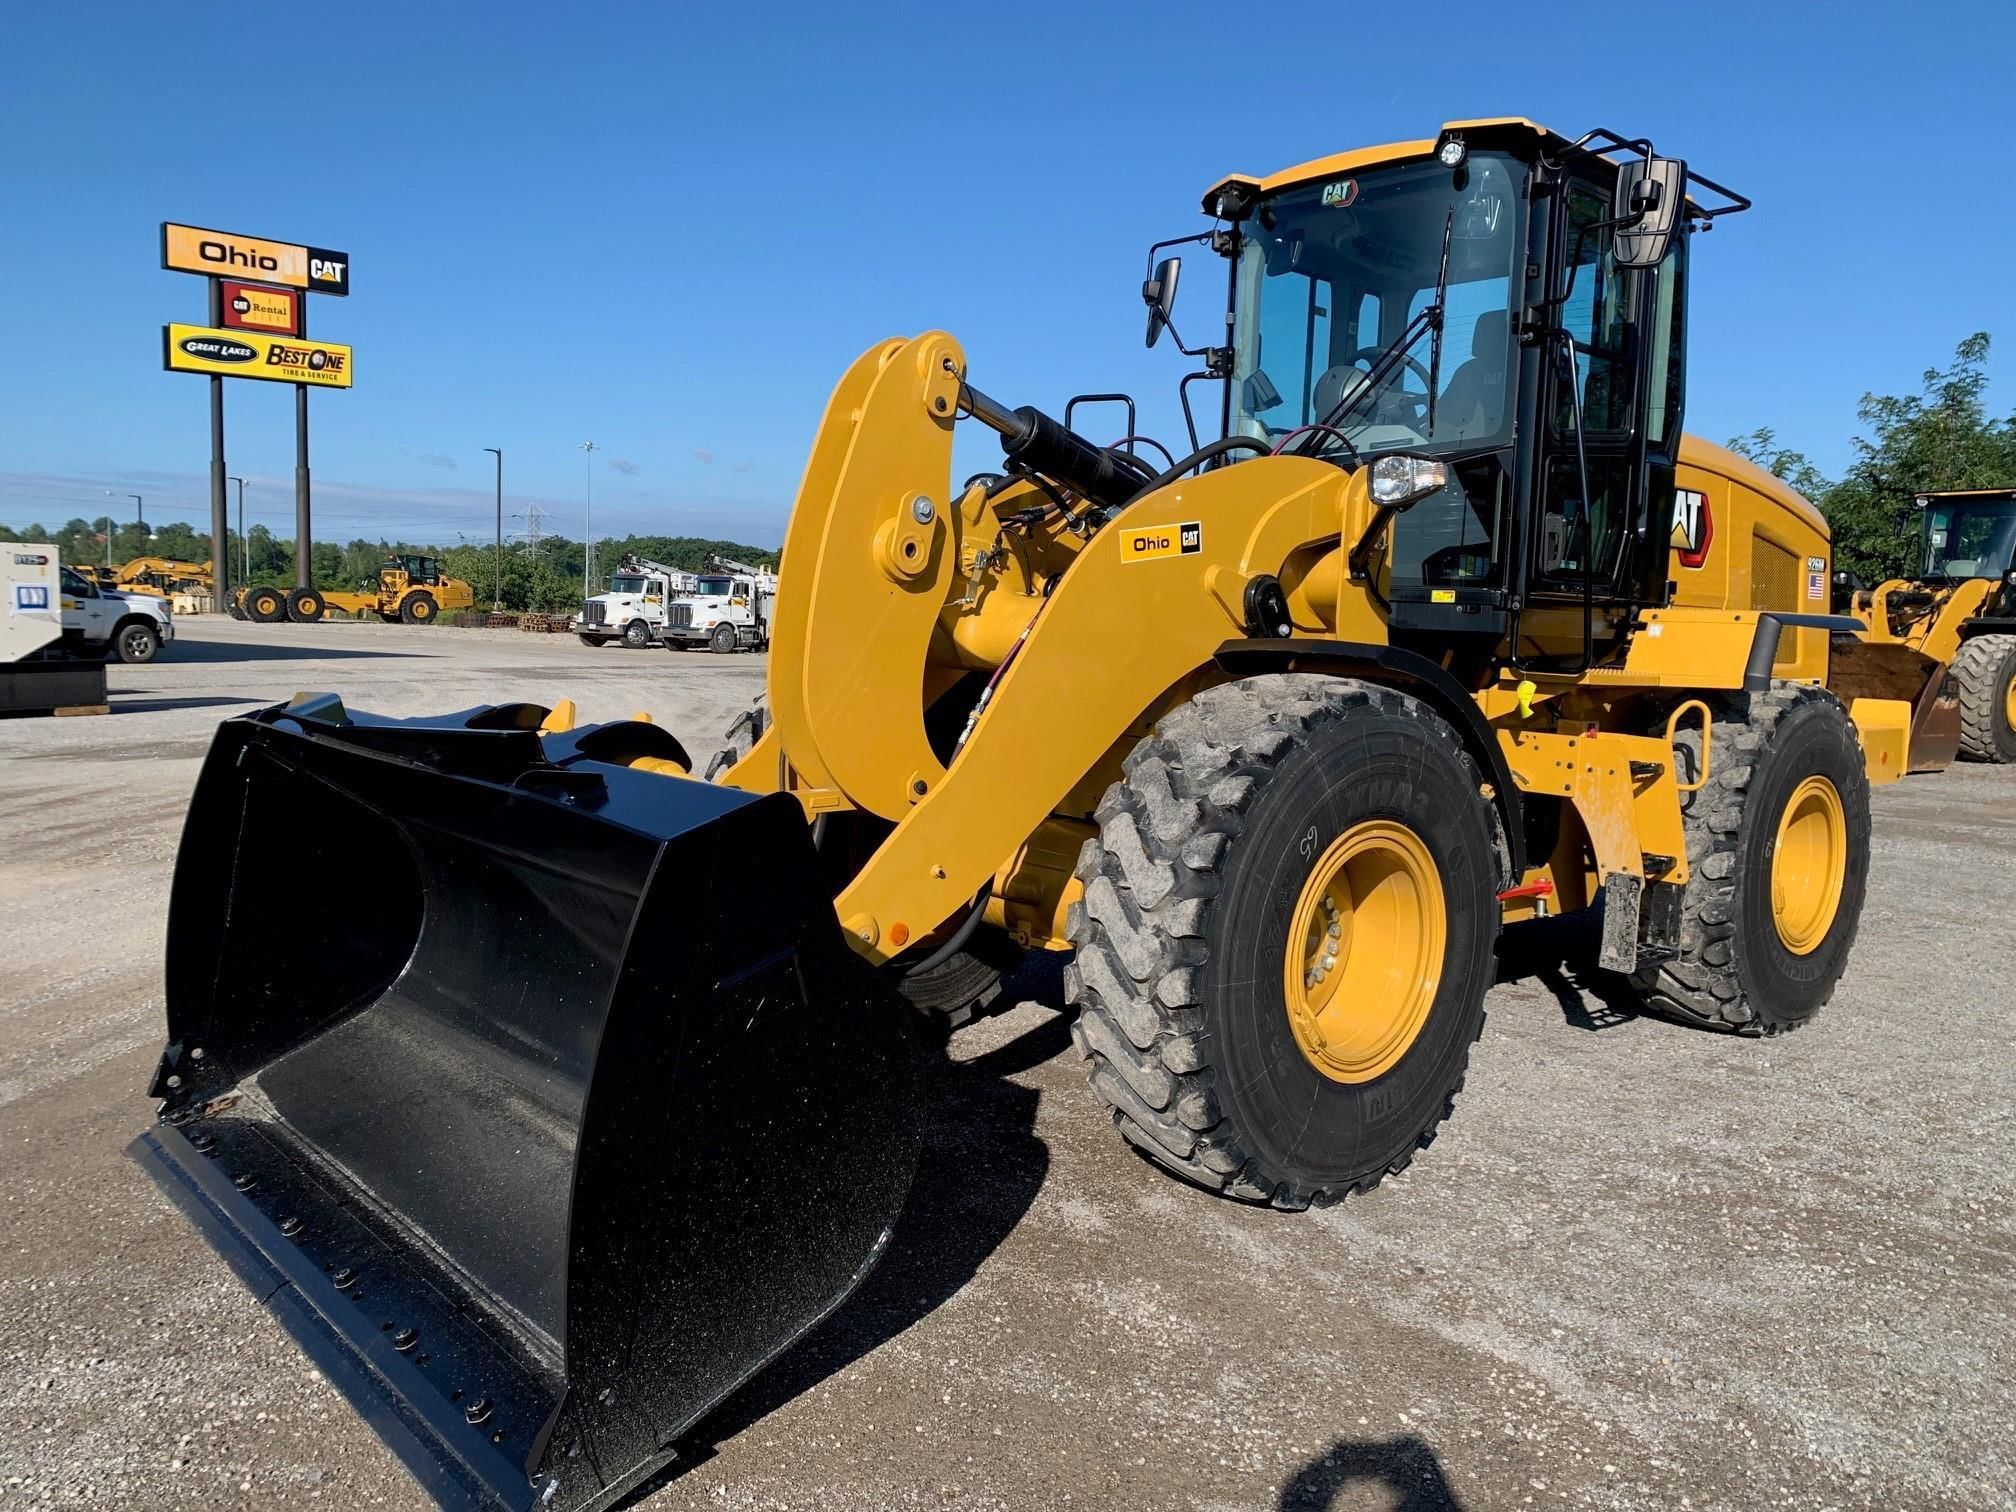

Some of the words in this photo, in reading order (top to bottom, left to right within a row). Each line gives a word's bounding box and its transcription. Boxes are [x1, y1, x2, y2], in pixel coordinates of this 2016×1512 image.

[1322, 181, 1350, 204] CAT
[199, 240, 278, 271] Ohio
[310, 258, 343, 283] CAT
[253, 303, 287, 315] Rental
[186, 341, 220, 353] GREAT
[221, 346, 251, 357] LAKES
[282, 368, 298, 377] TIRE
[307, 371, 338, 381] SERVICE
[1670, 490, 1702, 549] AT
[1133, 536, 1170, 552] Ohio
[1182, 531, 1199, 547] CAT
